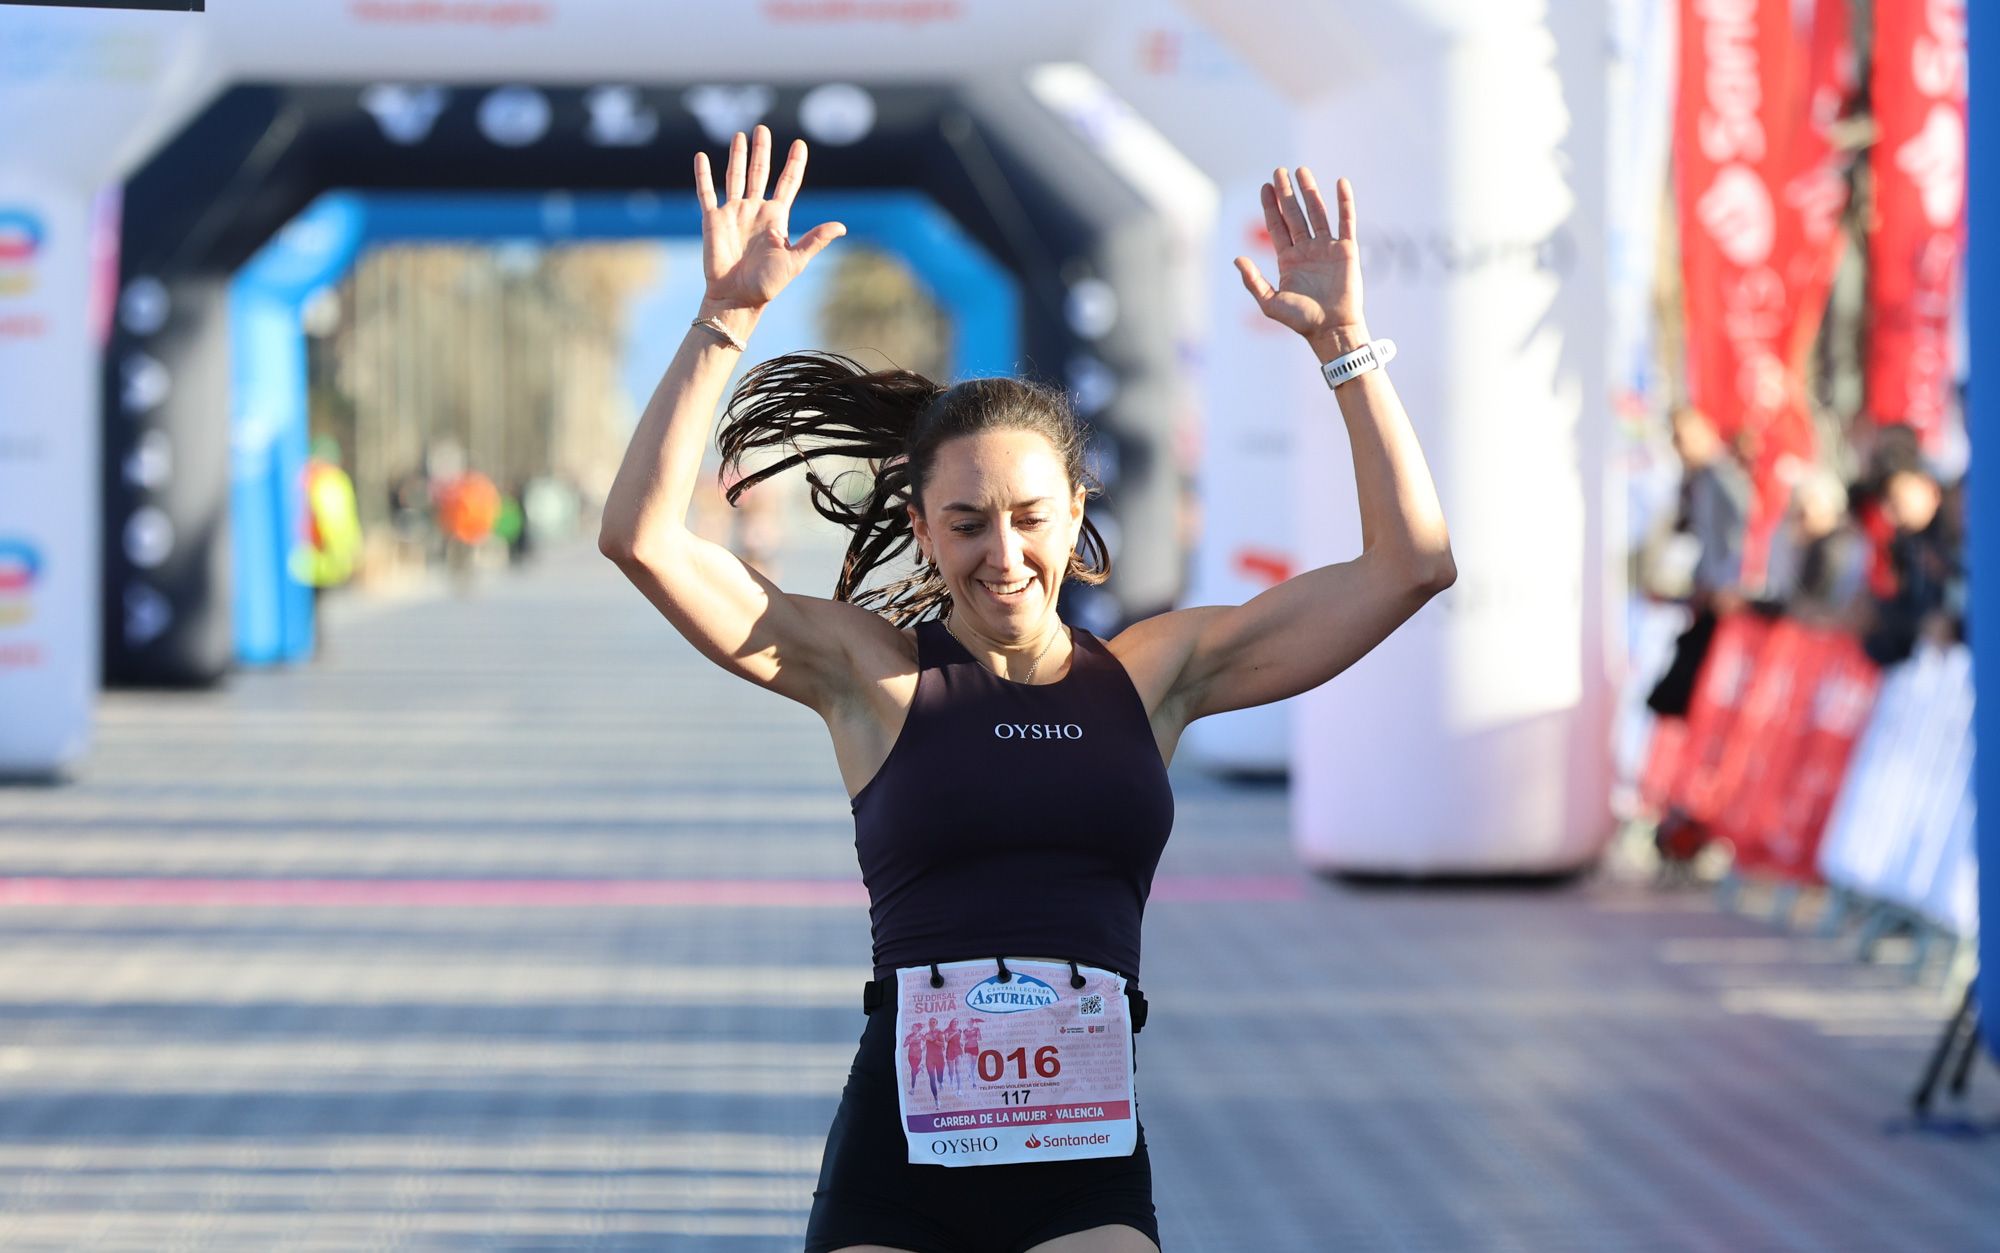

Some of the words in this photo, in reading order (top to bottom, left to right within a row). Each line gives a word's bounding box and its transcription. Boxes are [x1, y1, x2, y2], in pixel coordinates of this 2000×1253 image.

[359, 83, 878, 148] VOLVO
[994, 723, 1084, 740] OYSHO
[912, 994, 924, 1002] TU
[925, 991, 957, 1001] DORSAL
[972, 990, 1052, 1006] ASTURIANA
[914, 1000, 957, 1014] SUMA
[977, 1045, 1061, 1082] 016
[1001, 1090, 1031, 1105] 117
[933, 1115, 977, 1128] CARRERA
[979, 1113, 993, 1124] DE
[996, 1112, 1010, 1123] LA
[1012, 1110, 1047, 1122] MUJER
[1055, 1106, 1105, 1119] VALENCIA
[931, 1135, 998, 1156] OYSHO
[1043, 1132, 1111, 1148] Santander
